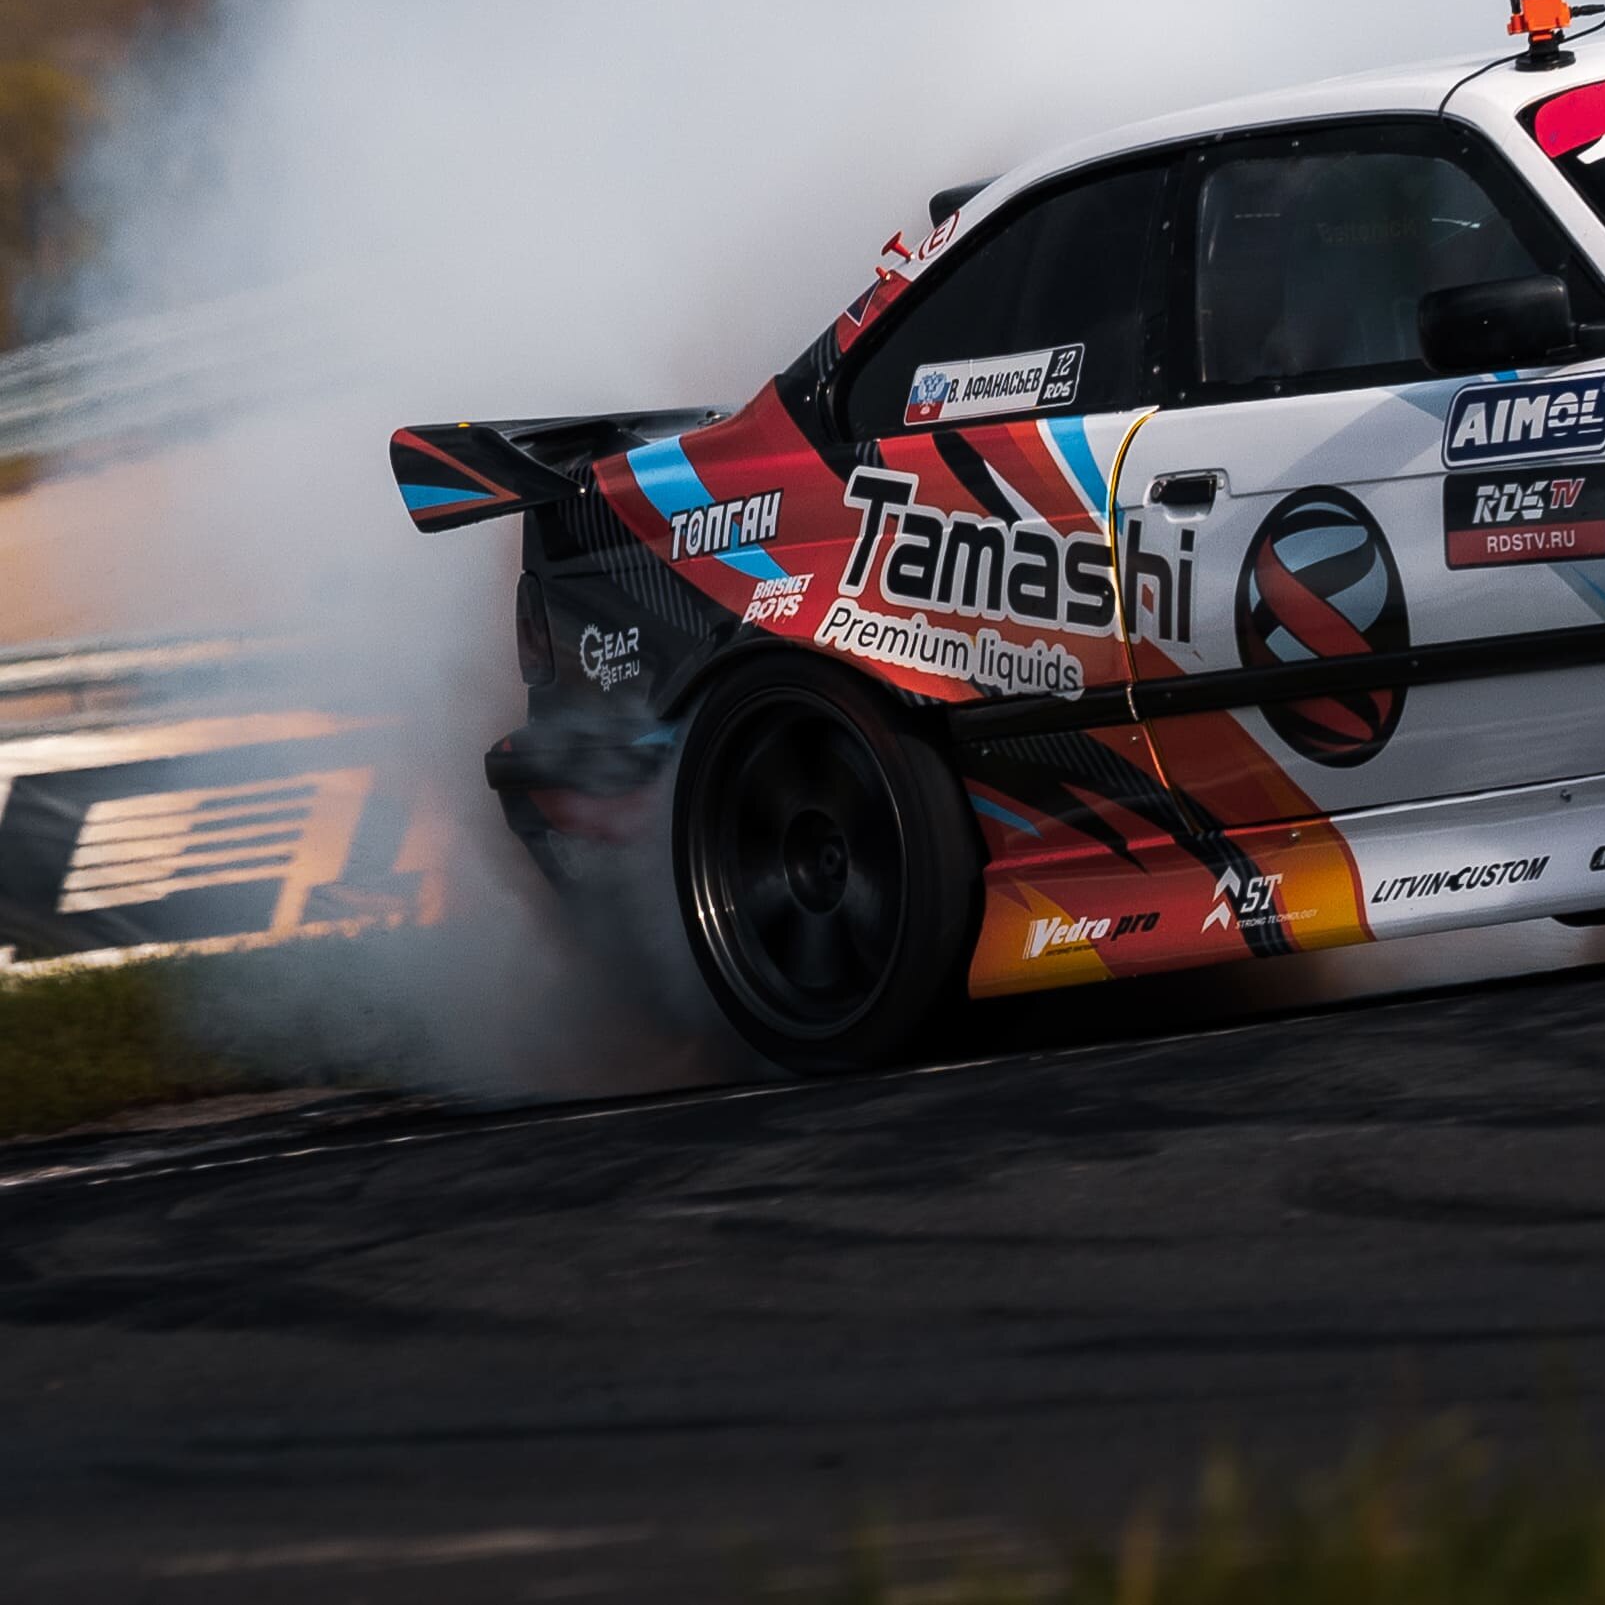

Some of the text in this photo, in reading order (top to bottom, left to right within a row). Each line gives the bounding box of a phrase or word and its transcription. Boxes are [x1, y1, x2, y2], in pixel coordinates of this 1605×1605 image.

[1051, 351, 1076, 378] 12
[963, 367, 1042, 401] АФАНАСЬЕВ
[1044, 381, 1073, 399] RDS
[1451, 389, 1604, 448] AIMOL
[1472, 478, 1585, 524] RDS TV
[671, 492, 782, 560] ТОПГАН
[1487, 530, 1575, 553] RDSTV.RU
[845, 474, 1195, 644] Tamashi
[752, 573, 814, 600] BRISKET
[741, 594, 803, 626] BOYS
[580, 623, 640, 679] GEAR
[822, 606, 1079, 691] Premium liquids
[1241, 874, 1282, 914] ST
[1236, 915, 1266, 930] STRONG
